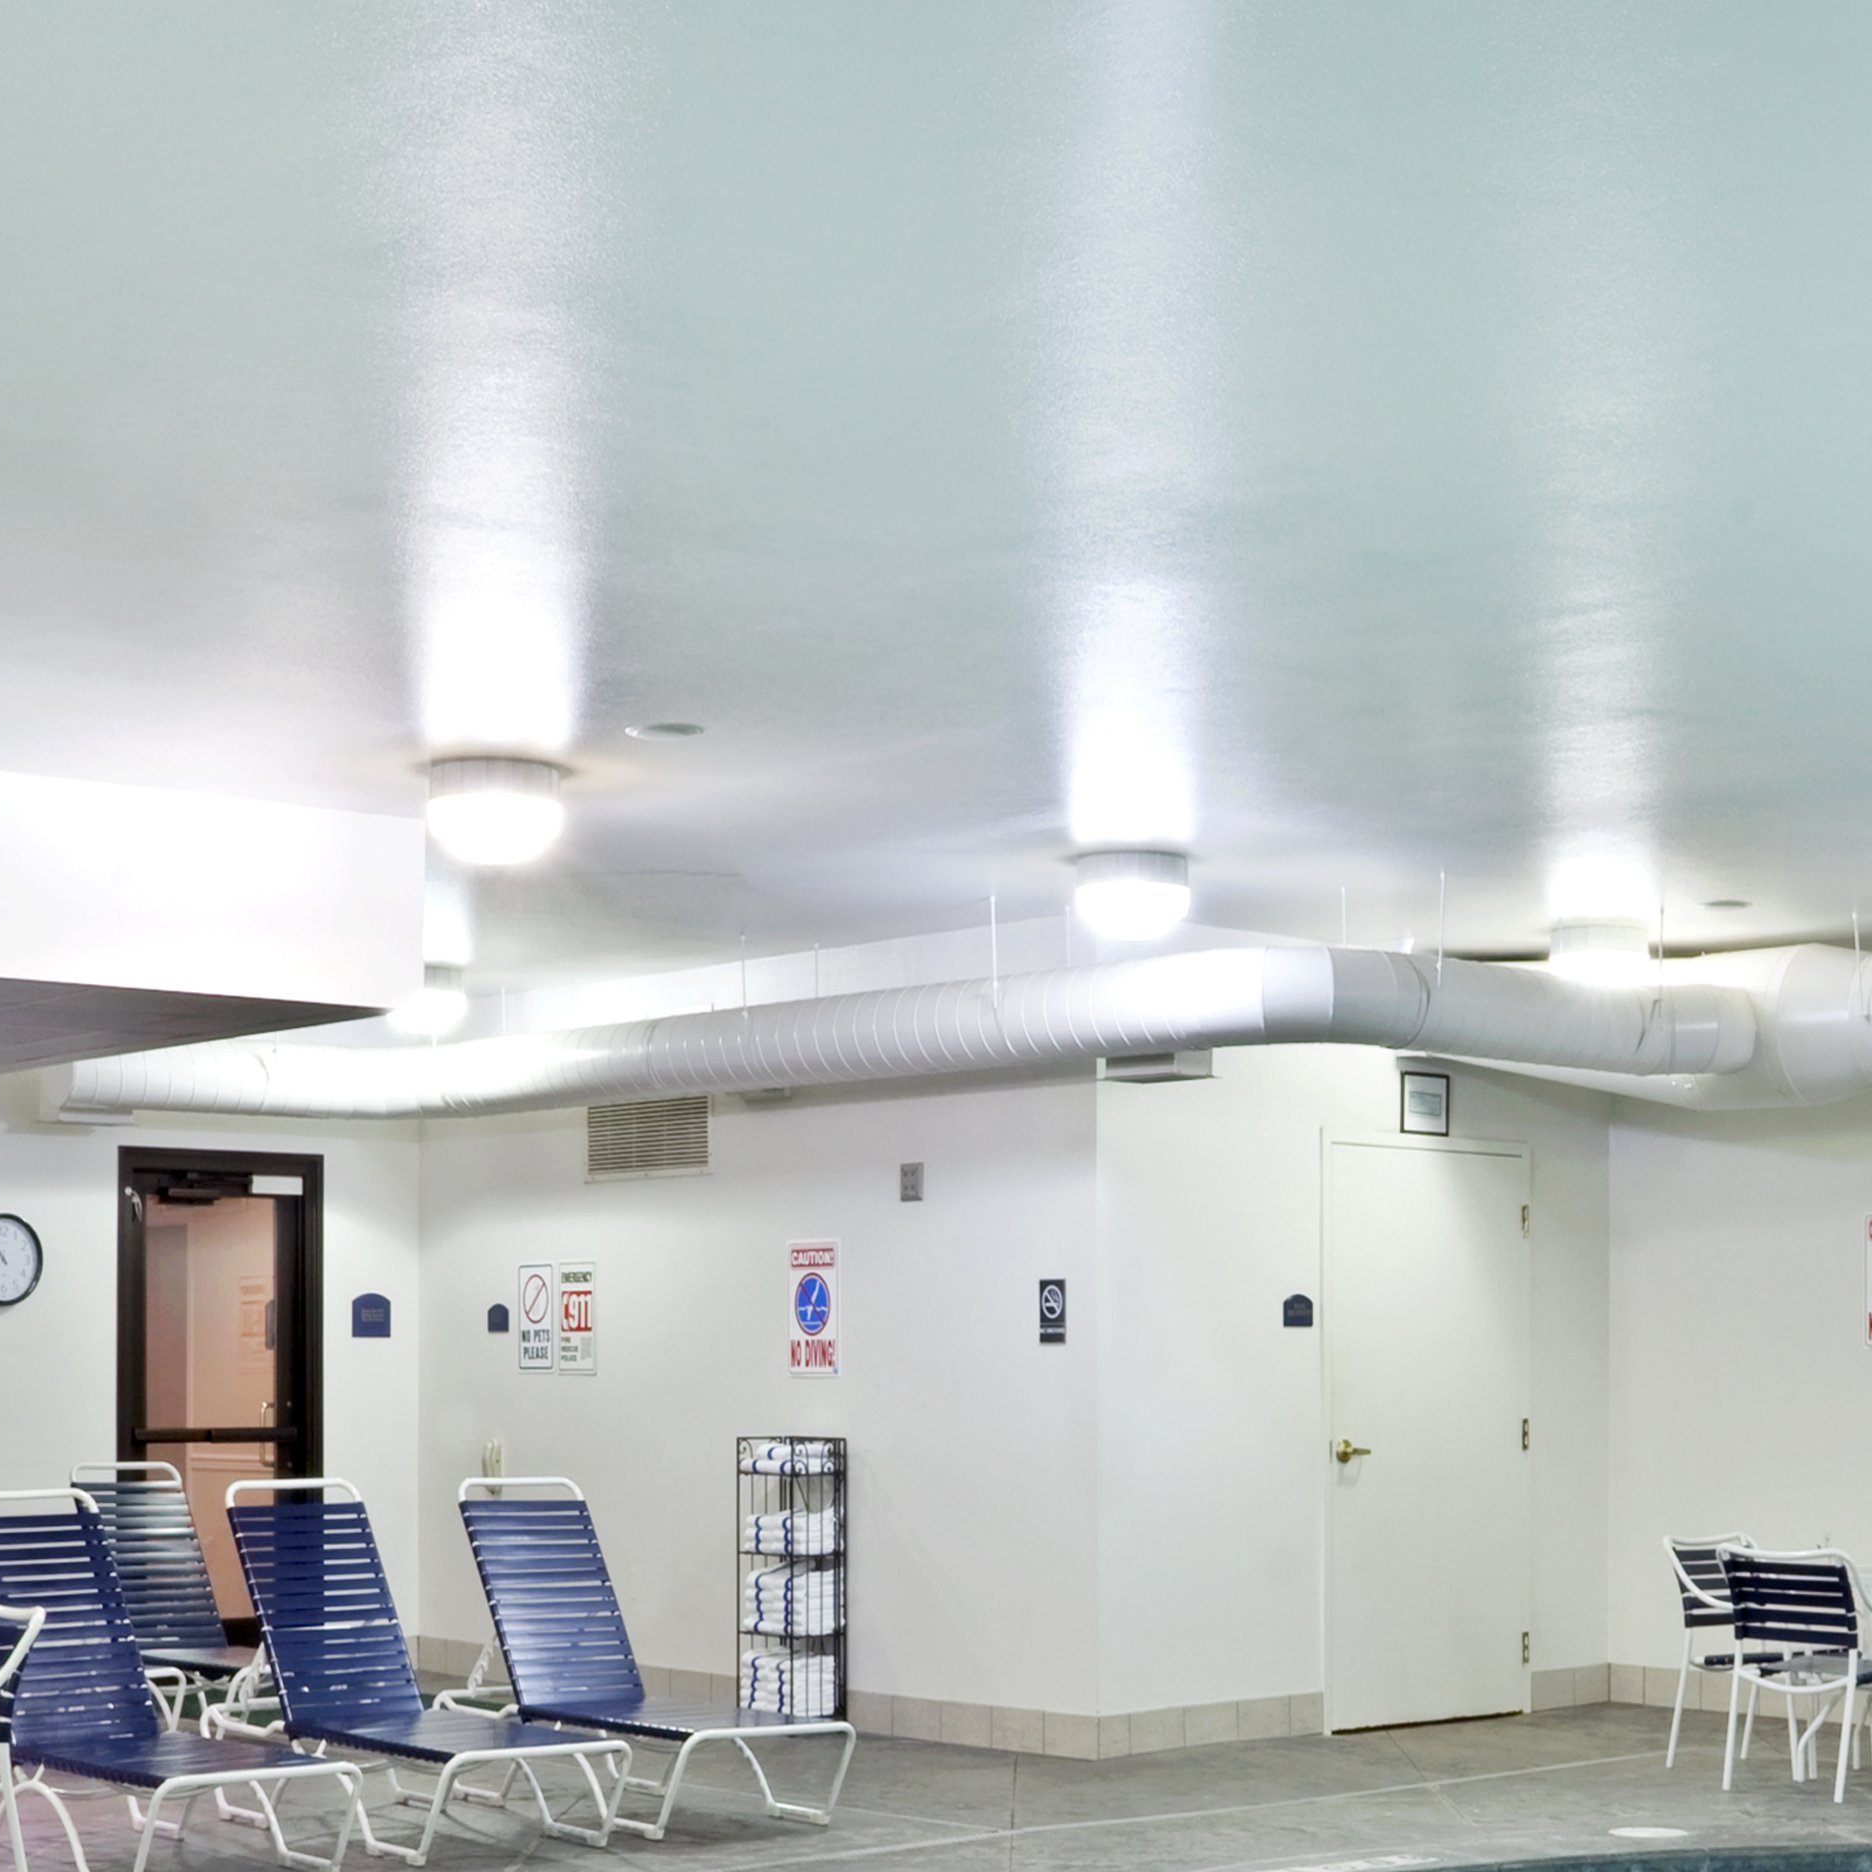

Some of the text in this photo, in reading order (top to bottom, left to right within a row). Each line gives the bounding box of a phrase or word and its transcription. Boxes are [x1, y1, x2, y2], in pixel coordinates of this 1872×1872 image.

[792, 1250, 834, 1265] CAUTION!
[522, 1330, 550, 1343] NO PETS
[523, 1347, 548, 1360] PLEASE
[791, 1339, 835, 1367] NO DIVING!
